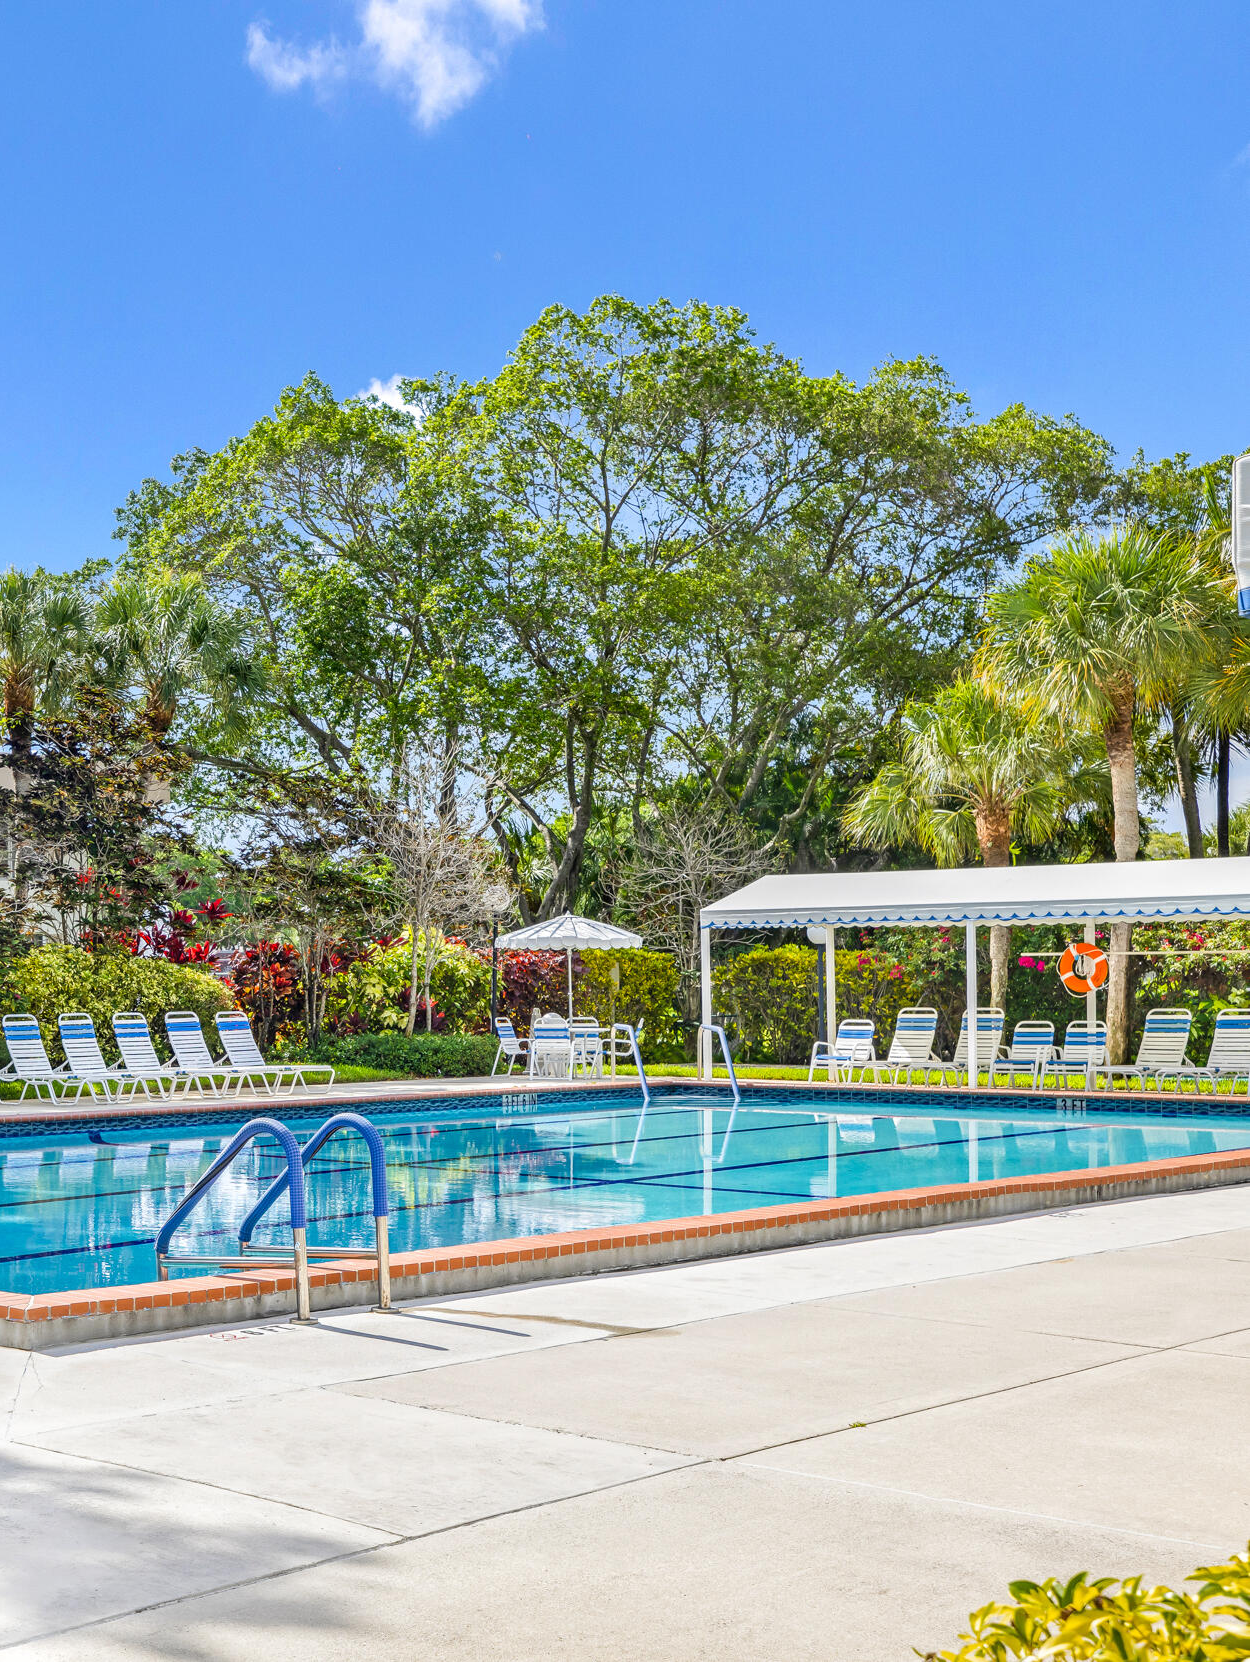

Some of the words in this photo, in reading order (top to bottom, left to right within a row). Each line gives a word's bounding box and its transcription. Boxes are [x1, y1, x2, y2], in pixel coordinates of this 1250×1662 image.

[511, 1094, 519, 1106] FT
[1061, 1098, 1067, 1110] 3
[1072, 1099, 1085, 1111] FT
